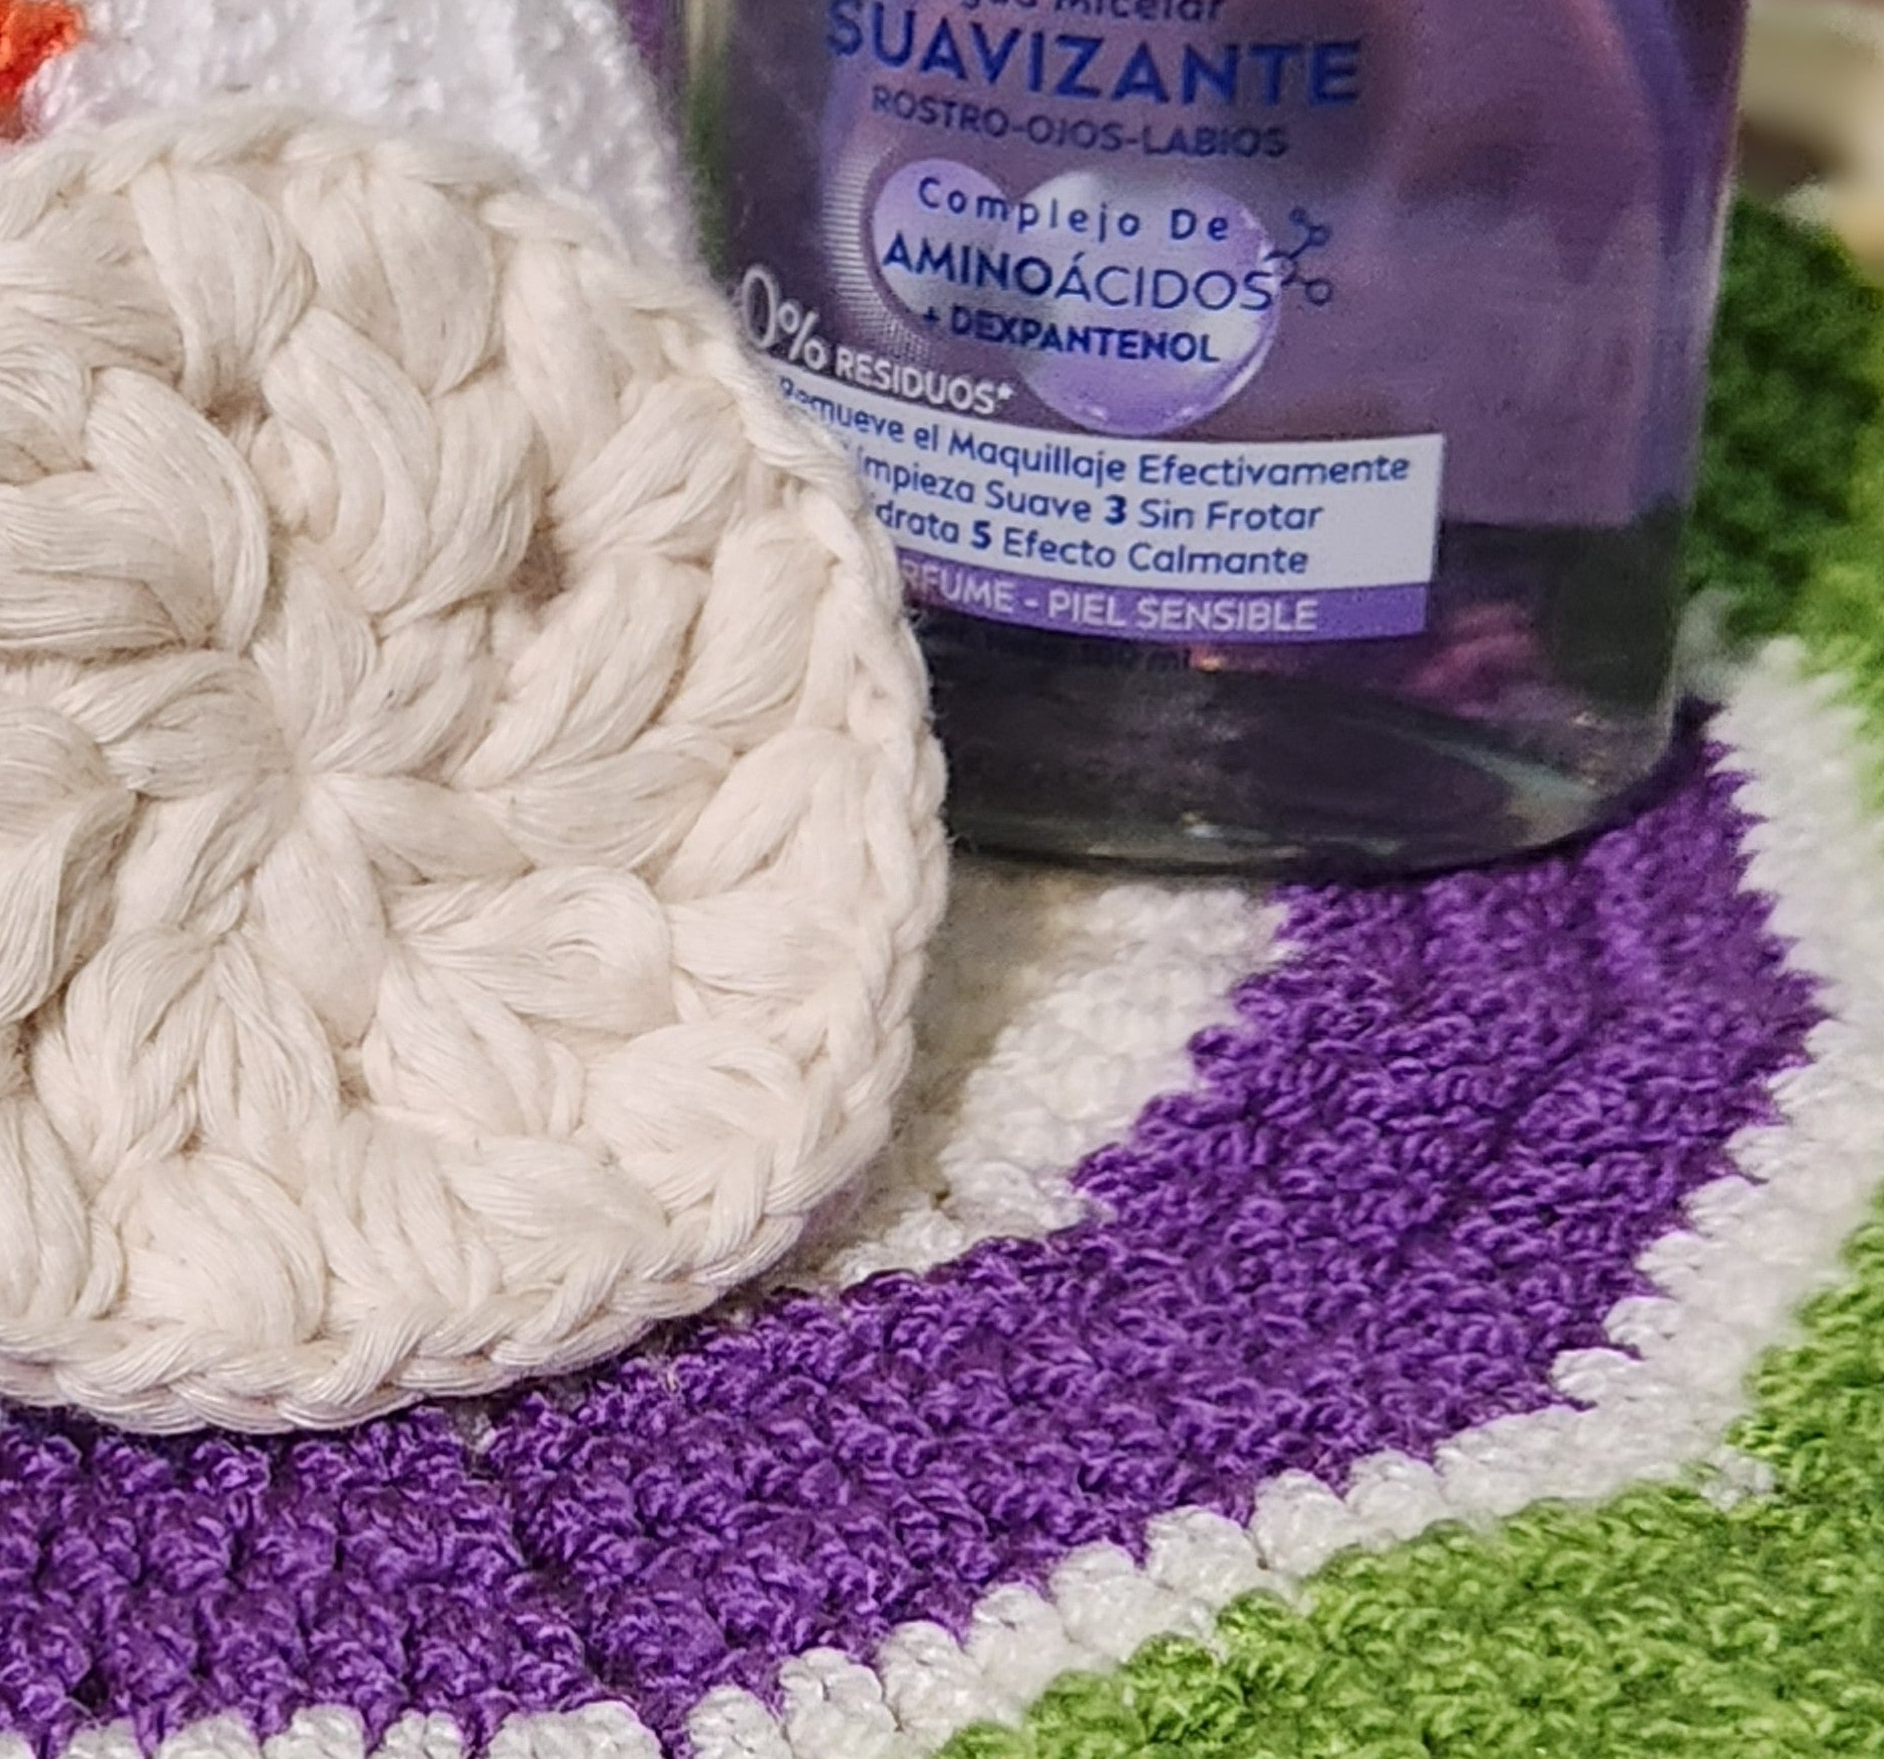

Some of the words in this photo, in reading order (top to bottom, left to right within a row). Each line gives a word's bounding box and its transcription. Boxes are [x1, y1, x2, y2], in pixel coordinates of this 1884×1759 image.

[871, 85, 1290, 158] ROSTRO-OJOS-LABIOS
[918, 176, 1141, 242] Complejo
[1171, 207, 1229, 241] De
[882, 232, 1274, 311] AMINOÁCIDOS
[740, 264, 827, 371] 0%
[922, 306, 941, 323] +
[951, 305, 1221, 362] DEXPANTENOL
[913, 424, 939, 451] el
[948, 429, 1127, 488] Maquillaje
[1138, 454, 1410, 487] Efectivamente
[985, 479, 1092, 523] Suave
[1104, 494, 1127, 525] 3
[1138, 498, 1195, 531] Sin
[1207, 500, 1325, 532] Frotar
[971, 520, 992, 550] 5
[1004, 527, 1116, 569] Efecto
[1128, 541, 1310, 575] Calmante
[899, 558, 1014, 614] RFUME
[1048, 589, 1127, 628] PIEL
[1136, 596, 1319, 633] SENSIBLE
